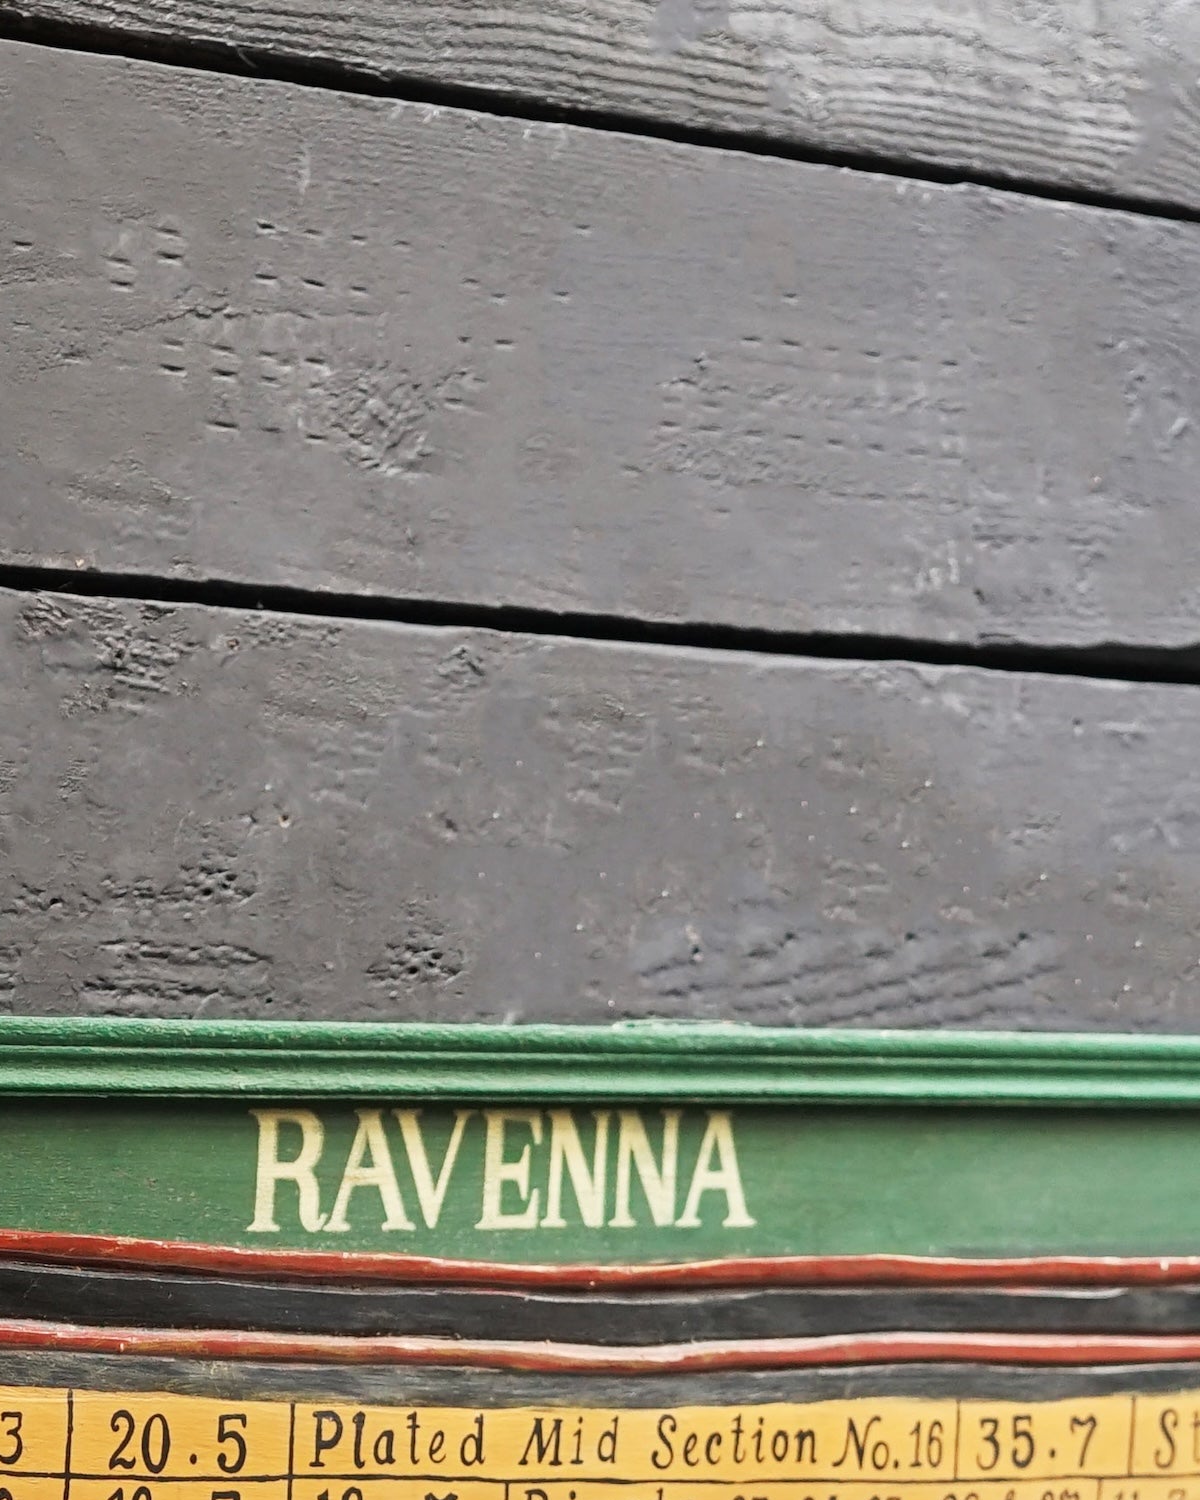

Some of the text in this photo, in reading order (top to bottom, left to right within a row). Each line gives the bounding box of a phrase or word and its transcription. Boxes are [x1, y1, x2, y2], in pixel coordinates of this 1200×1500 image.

[246, 1108, 757, 1233] RAVENNA
[108, 1409, 247, 1474] 20.5
[309, 1410, 486, 1469] Plated
[518, 1416, 619, 1467] Mid
[651, 1414, 816, 1470] Section
[976, 1415, 1098, 1471] 35.7
